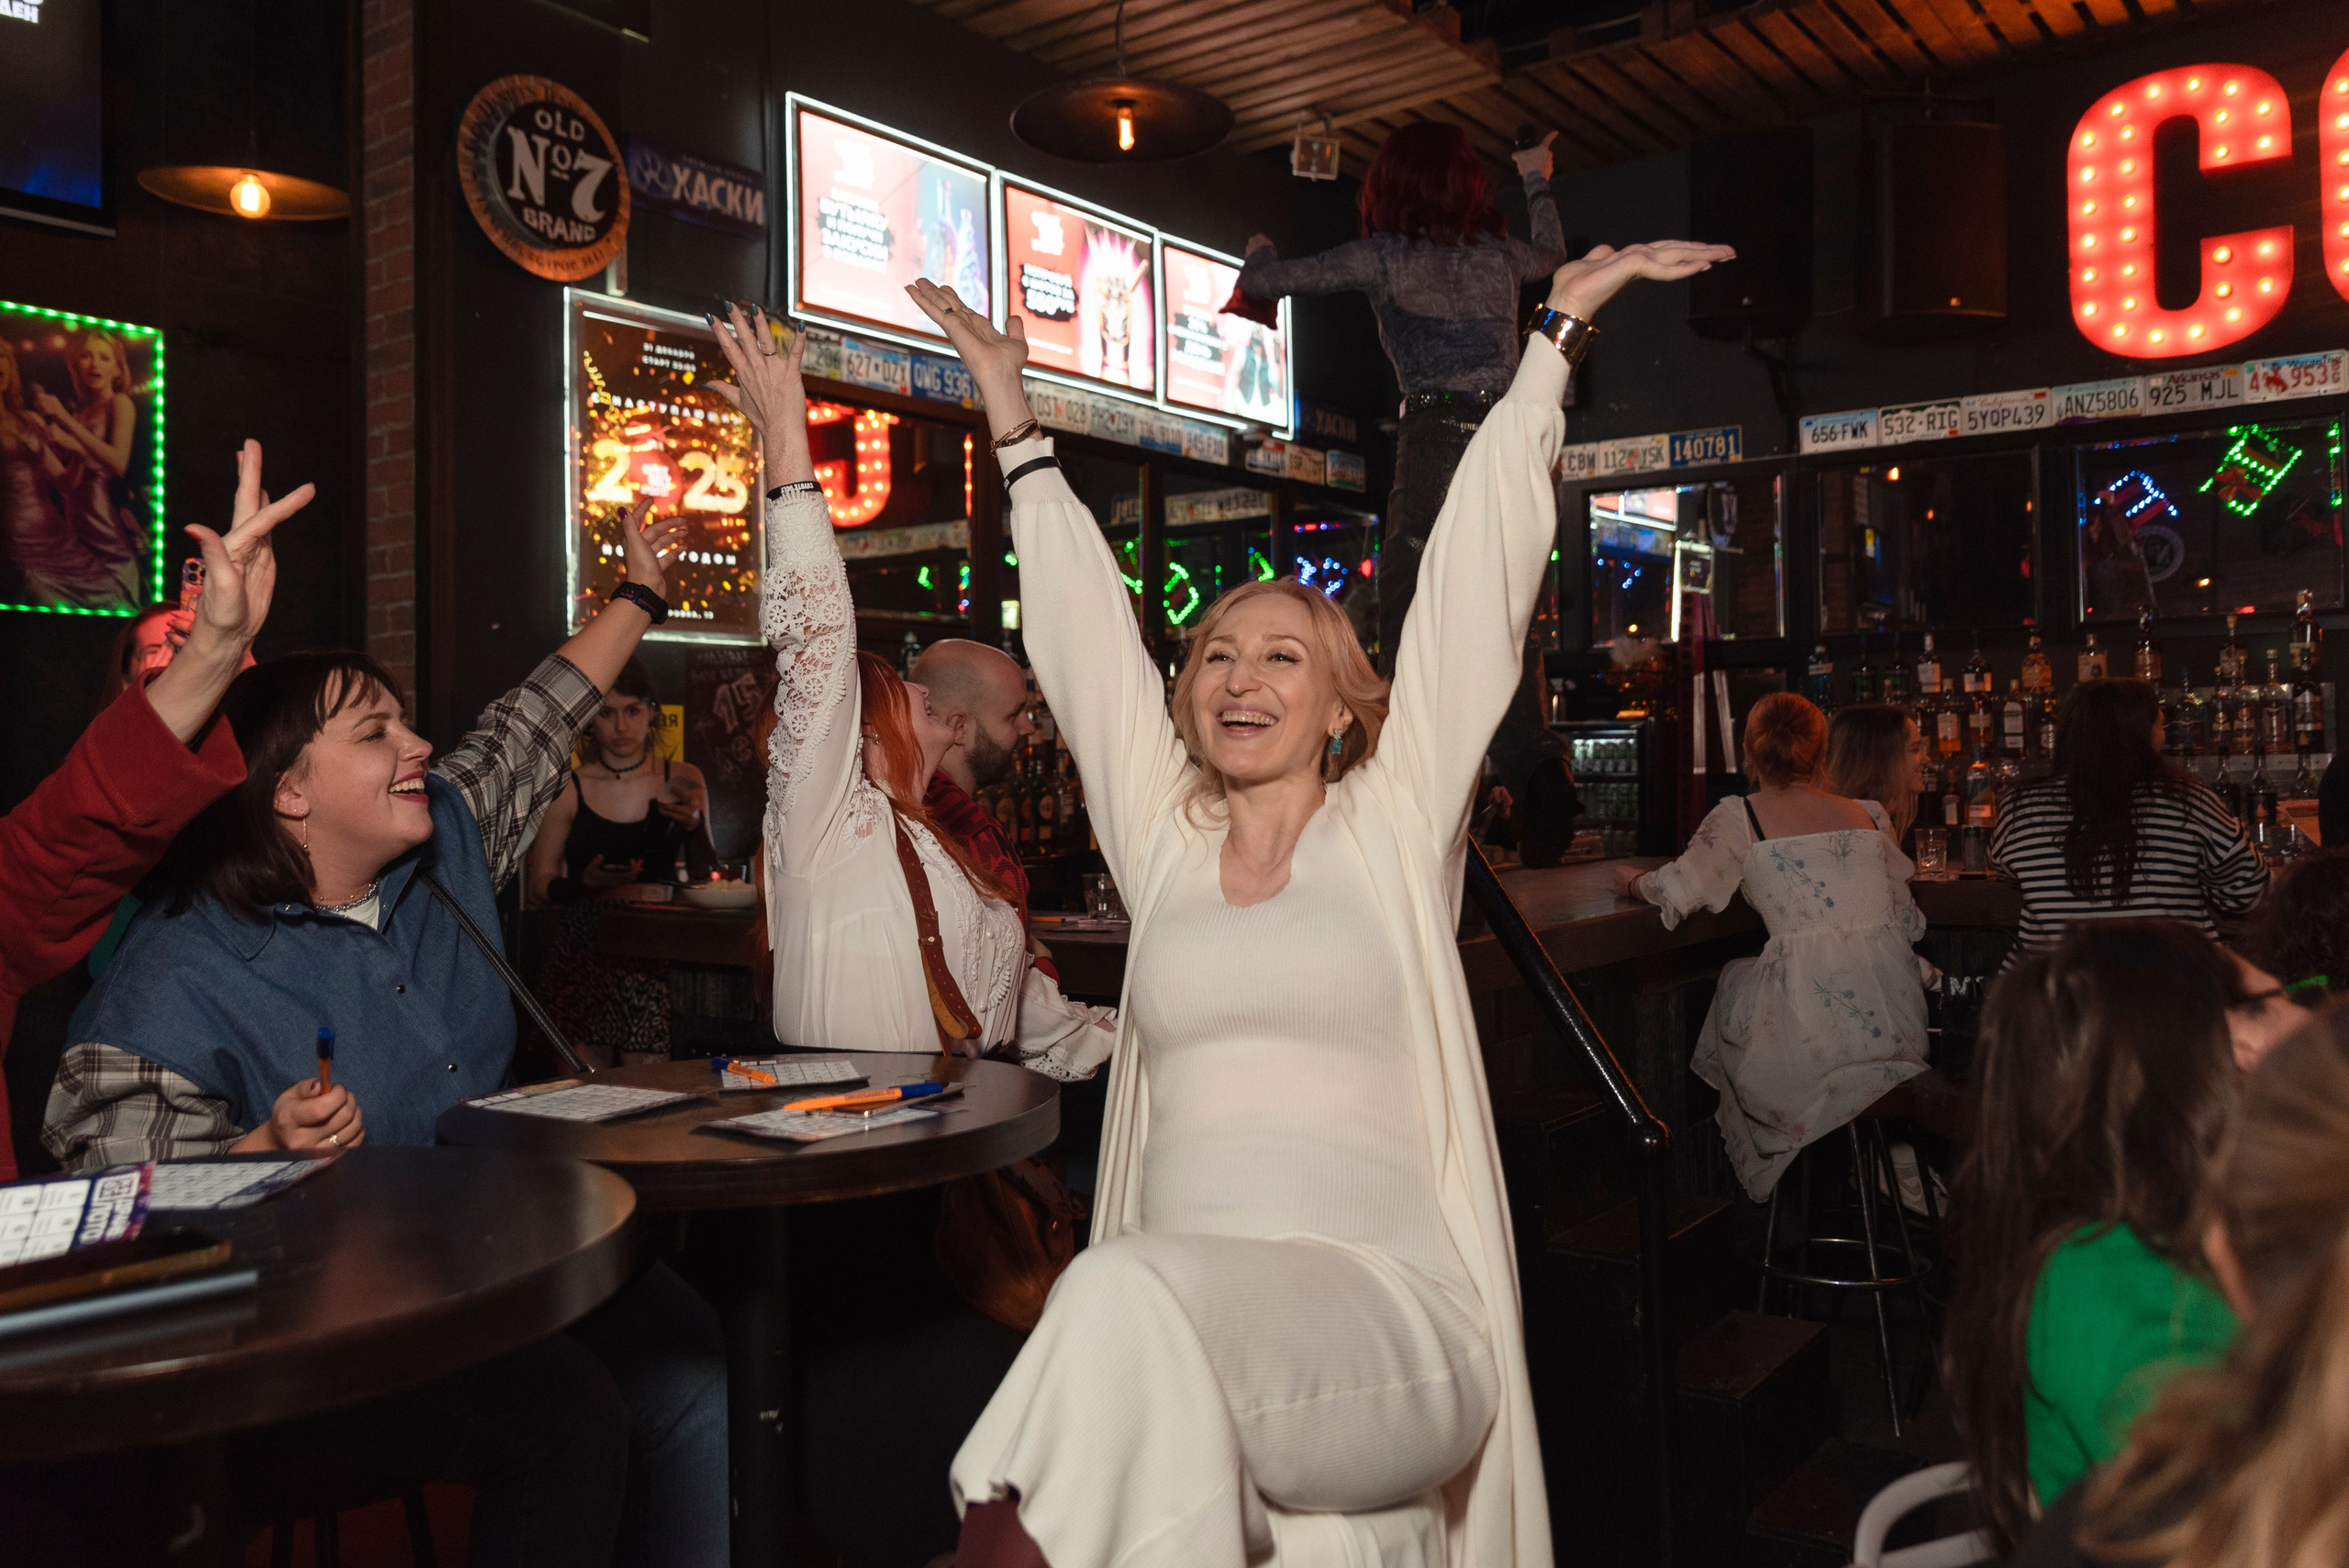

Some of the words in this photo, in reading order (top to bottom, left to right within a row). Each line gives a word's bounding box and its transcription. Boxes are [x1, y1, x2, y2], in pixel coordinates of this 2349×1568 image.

[534, 108, 585, 142] OLD
[671, 162, 764, 227] ХАСКИ
[522, 207, 596, 243] BRAND
[2166, 369, 2221, 385] Arkansas
[2065, 388, 2140, 415] ANZ5806
[2149, 384, 2188, 407] 925
[2200, 379, 2240, 403] MJL
[1674, 433, 1736, 462] 140781
